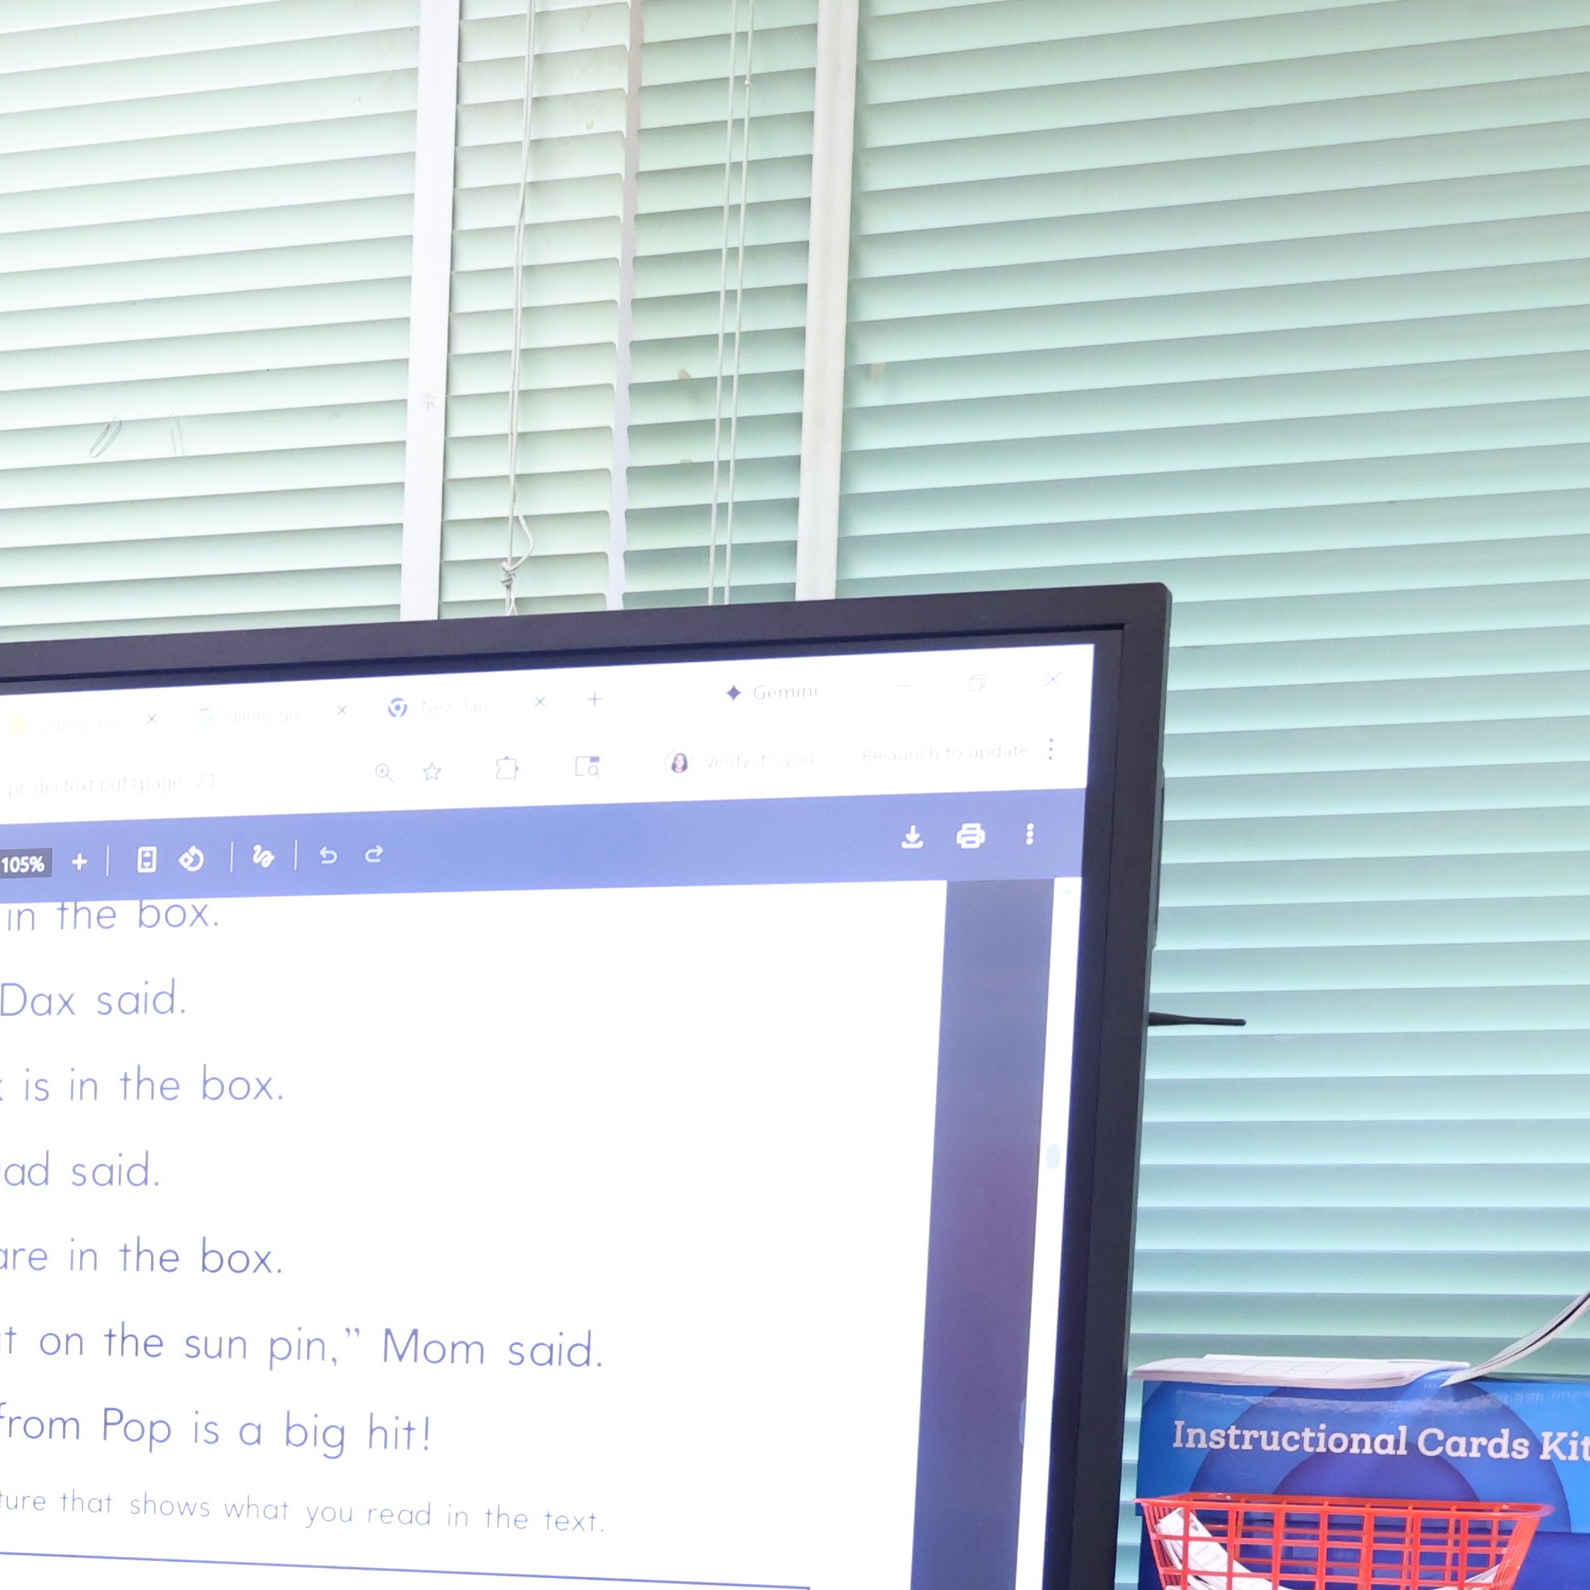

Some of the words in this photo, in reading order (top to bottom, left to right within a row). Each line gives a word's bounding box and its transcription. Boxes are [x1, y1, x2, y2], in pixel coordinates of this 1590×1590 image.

[862, 745, 939, 763] Relaunch
[945, 746, 963, 761] to
[968, 743, 1030, 765] update
[0, 856, 45, 874] 105%
[7, 907, 35, 932] in
[56, 901, 117, 931] the
[138, 900, 219, 929] box.
[0, 982, 76, 1018] Dax
[96, 977, 186, 1016] said.
[24, 1068, 50, 1102] is
[69, 1067, 98, 1101] in
[119, 1064, 181, 1102] the
[201, 1063, 284, 1101] box.
[70, 1149, 160, 1187] said.
[69, 1237, 98, 1272] in
[118, 1235, 180, 1273] the
[201, 1235, 283, 1274] box.
[39, 1332, 84, 1357] on
[103, 1320, 164, 1358] the
[184, 1335, 247, 1360] sun
[268, 1325, 361, 1372] pin,”
[383, 1327, 485, 1365] Mom
[507, 1328, 603, 1368] said.
[103, 1406, 172, 1454] Pop
[193, 1409, 220, 1446] is
[238, 1421, 263, 1446] a
[285, 1409, 346, 1460] big
[368, 1411, 430, 1452] hit!
[1172, 1420, 1408, 1456] Instructional
[1417, 1427, 1531, 1461] Cards
[60, 1488, 114, 1514] that
[129, 1491, 211, 1518] shows
[223, 1494, 291, 1520] what
[304, 1504, 353, 1529] you
[367, 1501, 432, 1527] read
[447, 1503, 469, 1528] in
[483, 1503, 529, 1530] the
[544, 1510, 605, 1532] text.
